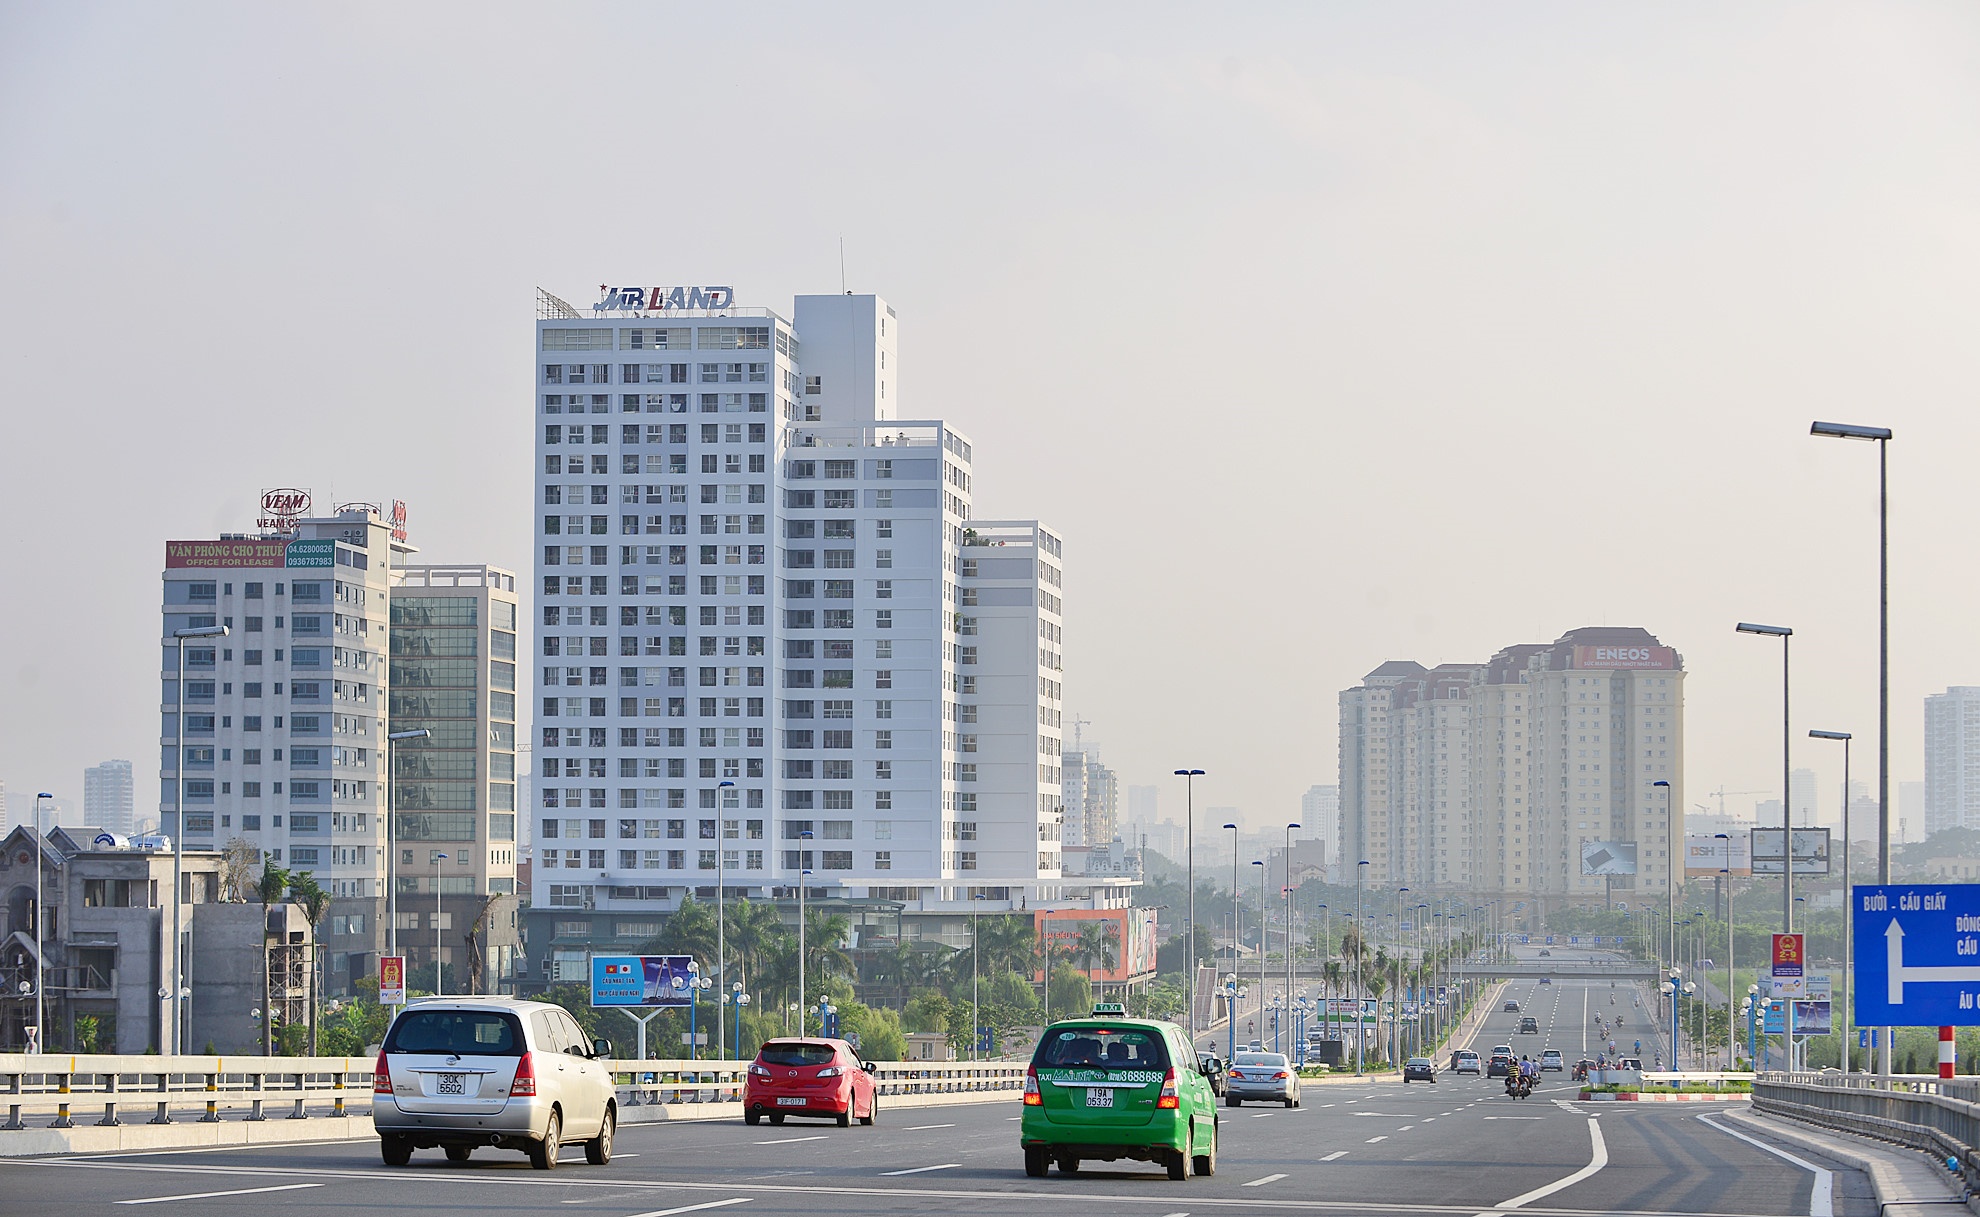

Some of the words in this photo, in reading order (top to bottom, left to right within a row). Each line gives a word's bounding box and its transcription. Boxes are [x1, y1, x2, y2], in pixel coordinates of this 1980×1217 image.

[648, 286, 733, 310] LAND
[265, 495, 306, 509] VEAM
[256, 518, 285, 528] VEAM
[168, 543, 191, 557] VĂN
[194, 543, 230, 557] PHÒNG
[232, 545, 255, 557] CHO
[255, 542, 284, 557] THUÊ
[186, 558, 219, 566] OFFICE
[222, 558, 241, 566] FOR
[243, 558, 274, 566] LEASE
[1596, 648, 1650, 660] ENEOS
[1863, 889, 1887, 911] BƯỞI
[1924, 891, 1947, 911] GIẤY
[1959, 990, 1973, 1009] ÂU
[443, 1074, 460, 1084] 30K
[1038, 1073, 1052, 1081] TAXI
[440, 1083, 462, 1094] 5502
[1093, 1088, 1107, 1098] 19A
